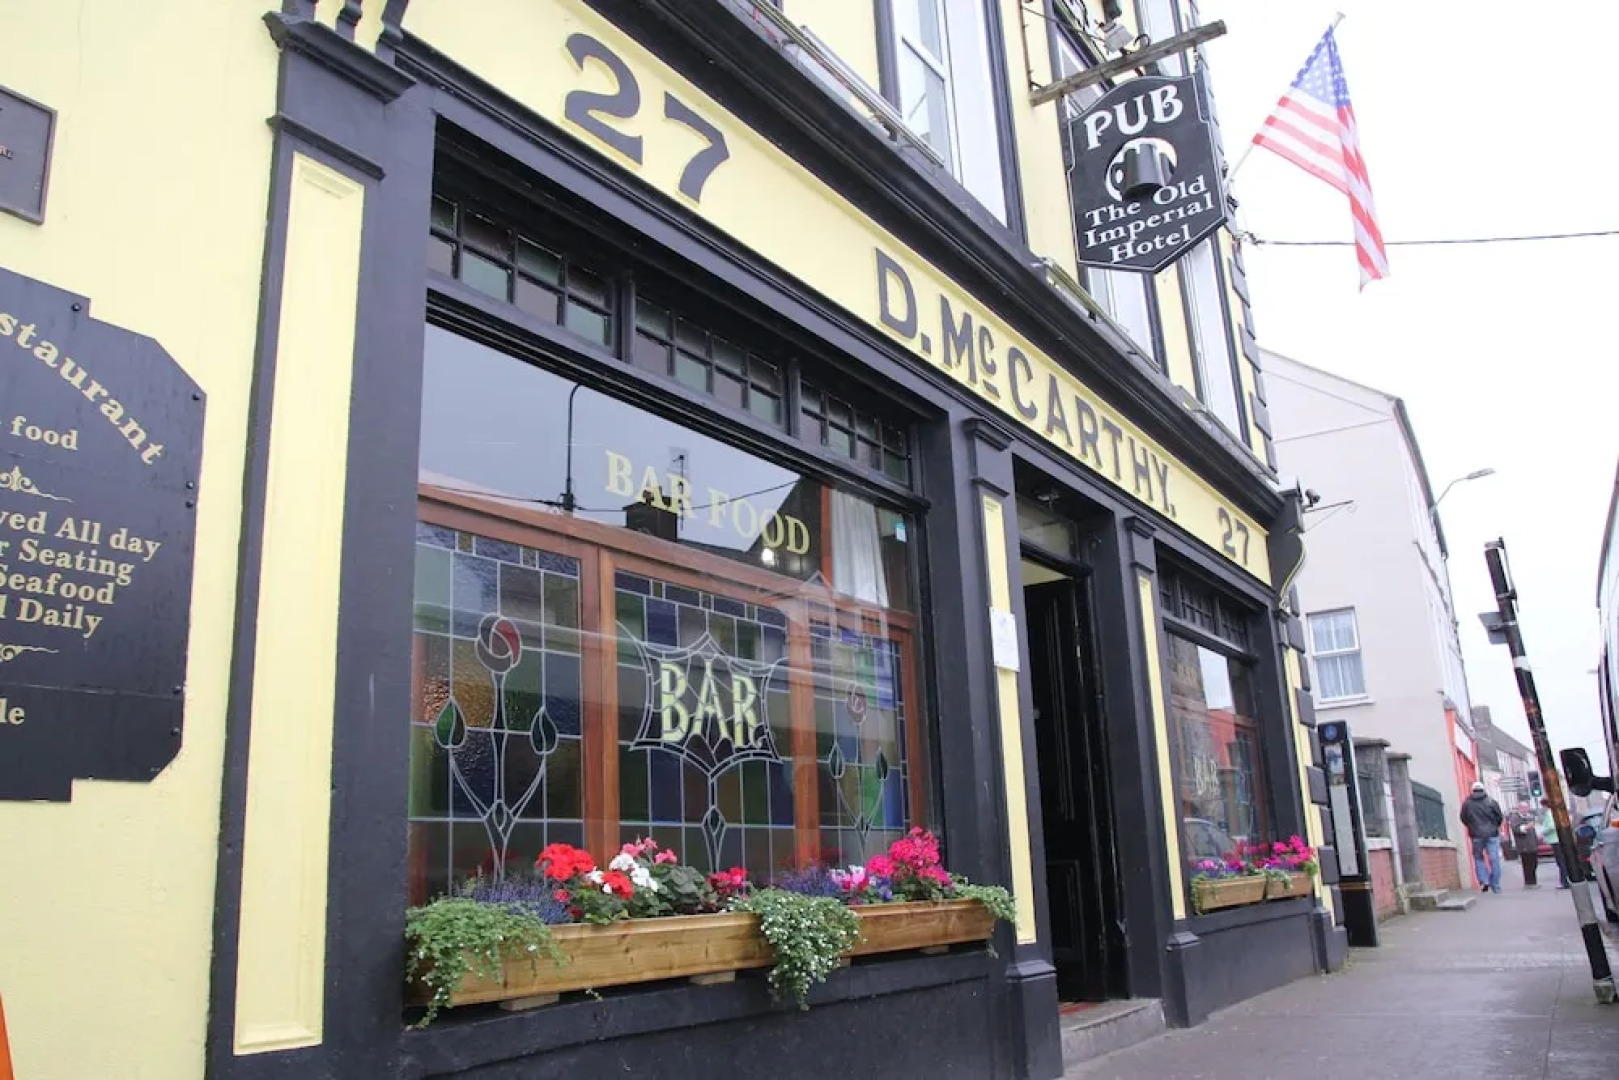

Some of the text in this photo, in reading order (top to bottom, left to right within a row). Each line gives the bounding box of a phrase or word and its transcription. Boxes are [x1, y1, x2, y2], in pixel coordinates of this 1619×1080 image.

[564, 33, 730, 204] 27
[1083, 84, 1183, 150] PUB
[1084, 191, 1215, 249] Imperial
[1085, 174, 1208, 228] The Old
[1108, 223, 1191, 263] Hotel
[10, 415, 79, 451] food
[604, 449, 811, 555] BAR FOOD
[18, 538, 136, 587] Seating
[54, 516, 102, 545] All
[109, 527, 162, 563] day
[1217, 505, 1250, 566] 27
[16, 598, 103, 638] Daily
[660, 658, 769, 751] BAR
